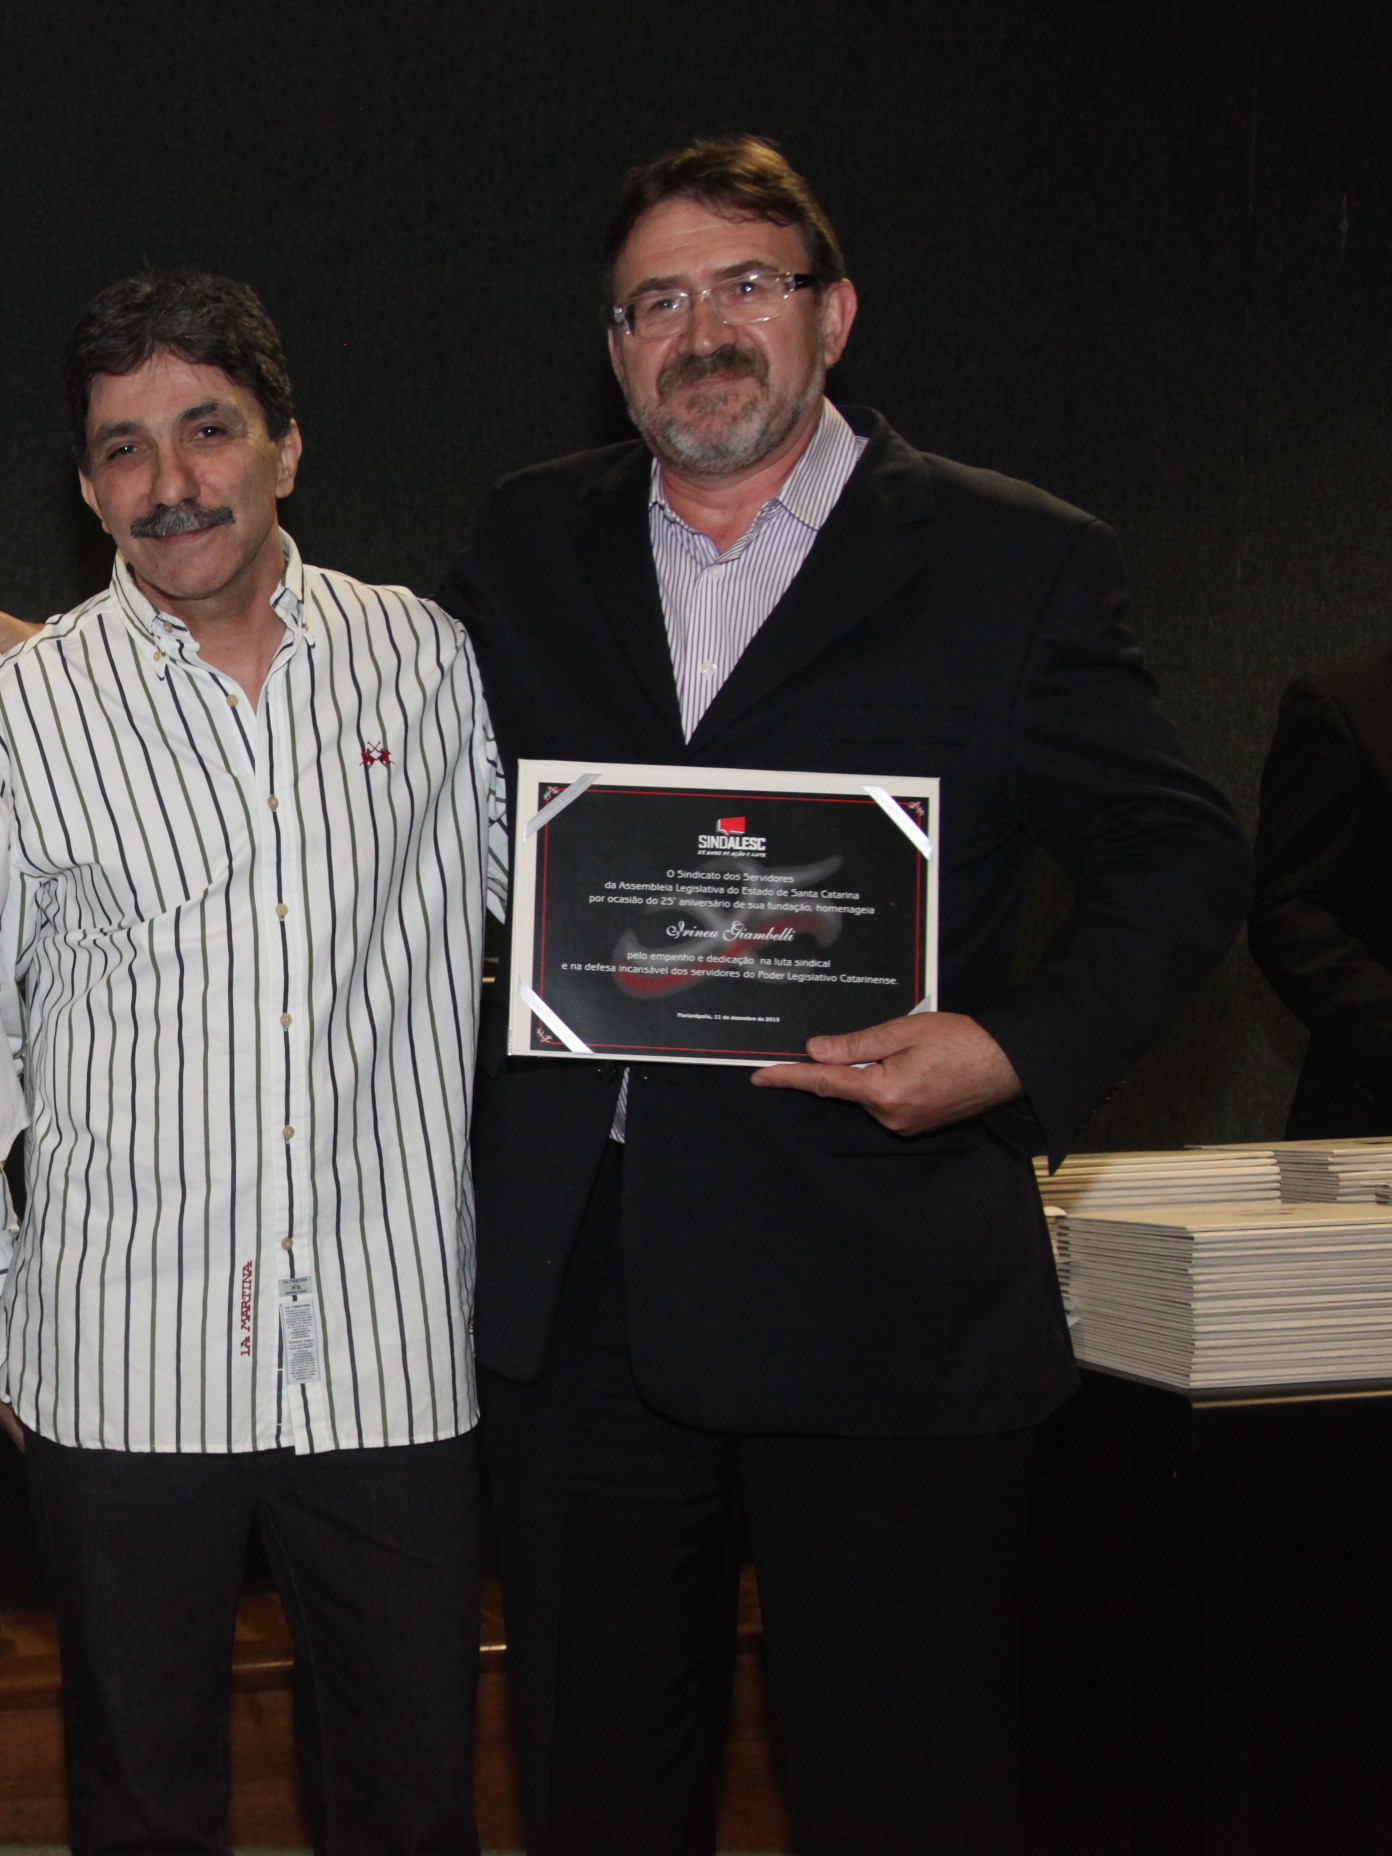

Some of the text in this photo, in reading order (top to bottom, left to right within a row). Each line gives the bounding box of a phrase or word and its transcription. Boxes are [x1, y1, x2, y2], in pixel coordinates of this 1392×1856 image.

[698, 835, 766, 850] SINDALESC
[666, 870, 794, 883] O Sindicato dos Servidores
[619, 882, 673, 891] Assembleia
[676, 884, 724, 894] Legislativa
[742, 887, 774, 896] Estado
[776, 888, 788, 896] de
[791, 889, 818, 898] Santa
[821, 890, 859, 900] Catarina
[589, 895, 605, 903] por
[607, 895, 643, 904] ocasião
[679, 898, 730, 908] aniversário
[767, 902, 813, 913] fundação,
[816, 904, 875, 915] homenageia
[666, 920, 796, 941] Irineu Giambelli
[627, 952, 648, 961] pelo
[650, 953, 695, 962] empenho
[707, 954, 754, 966] dedicação
[774, 958, 792, 966] luta
[794, 959, 831, 968] sindical
[585, 963, 616, 972] defesa
[619, 965, 668, 974] incansável
[671, 967, 688, 975] dos
[691, 968, 740, 978] servidores
[743, 970, 755, 978] do
[758, 971, 784, 980] Poder
[788, 972, 837, 982] Legislativo
[840, 974, 899, 985] Catarinense.
[240, 1260, 252, 1356] LA MARTINA
